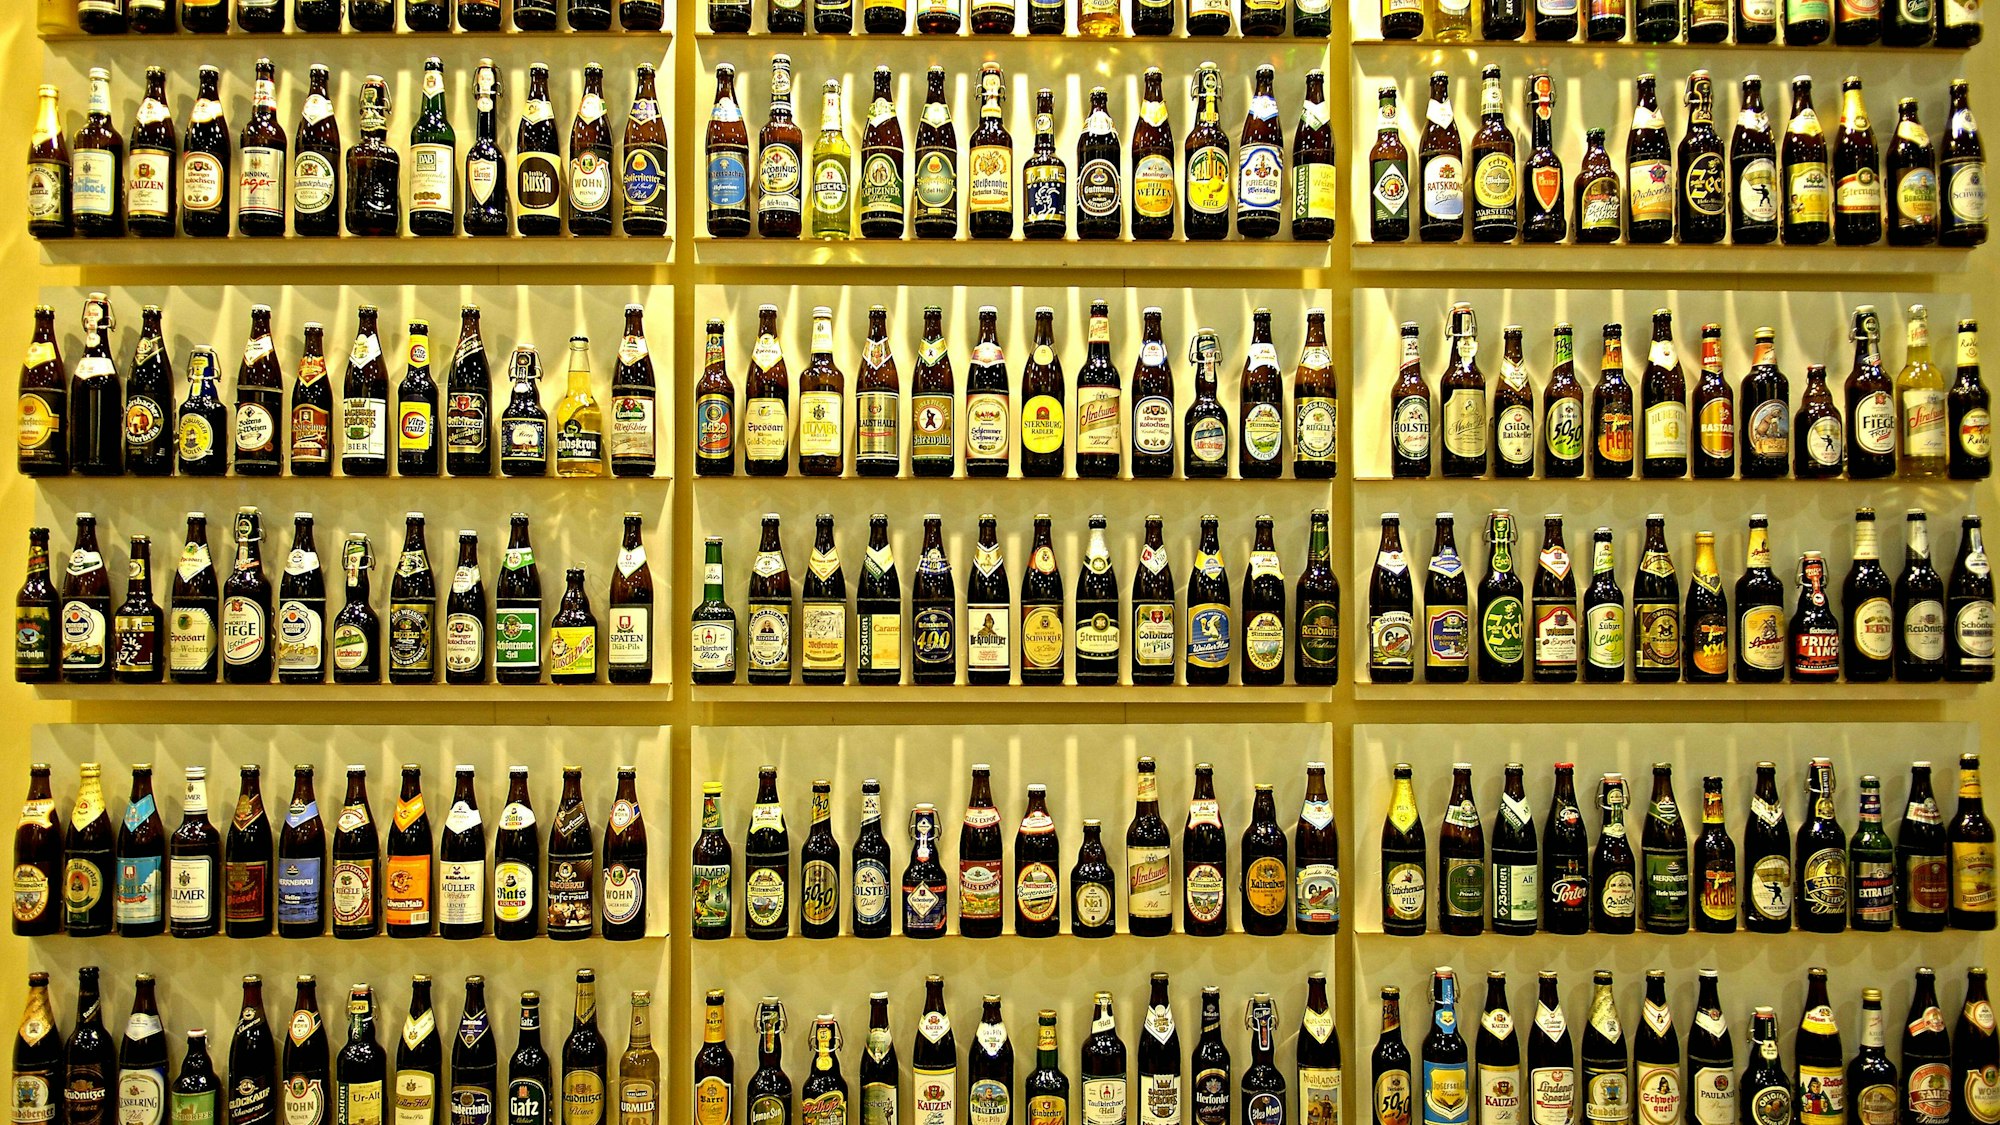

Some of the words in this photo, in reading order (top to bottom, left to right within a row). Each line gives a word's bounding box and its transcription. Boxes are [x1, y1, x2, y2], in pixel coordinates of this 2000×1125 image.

[348, 443, 367, 451] BIER
[694, 867, 726, 876] ULMER
[1522, 875, 1533, 884] Alt
[497, 887, 526, 899] Rats
[1401, 896, 1416, 905] PILS
[353, 1090, 381, 1102] Ur-Alt
[510, 1097, 539, 1116] Gatz
[917, 1099, 951, 1110] KAUZEN
[1653, 1102, 1673, 1114] quell
